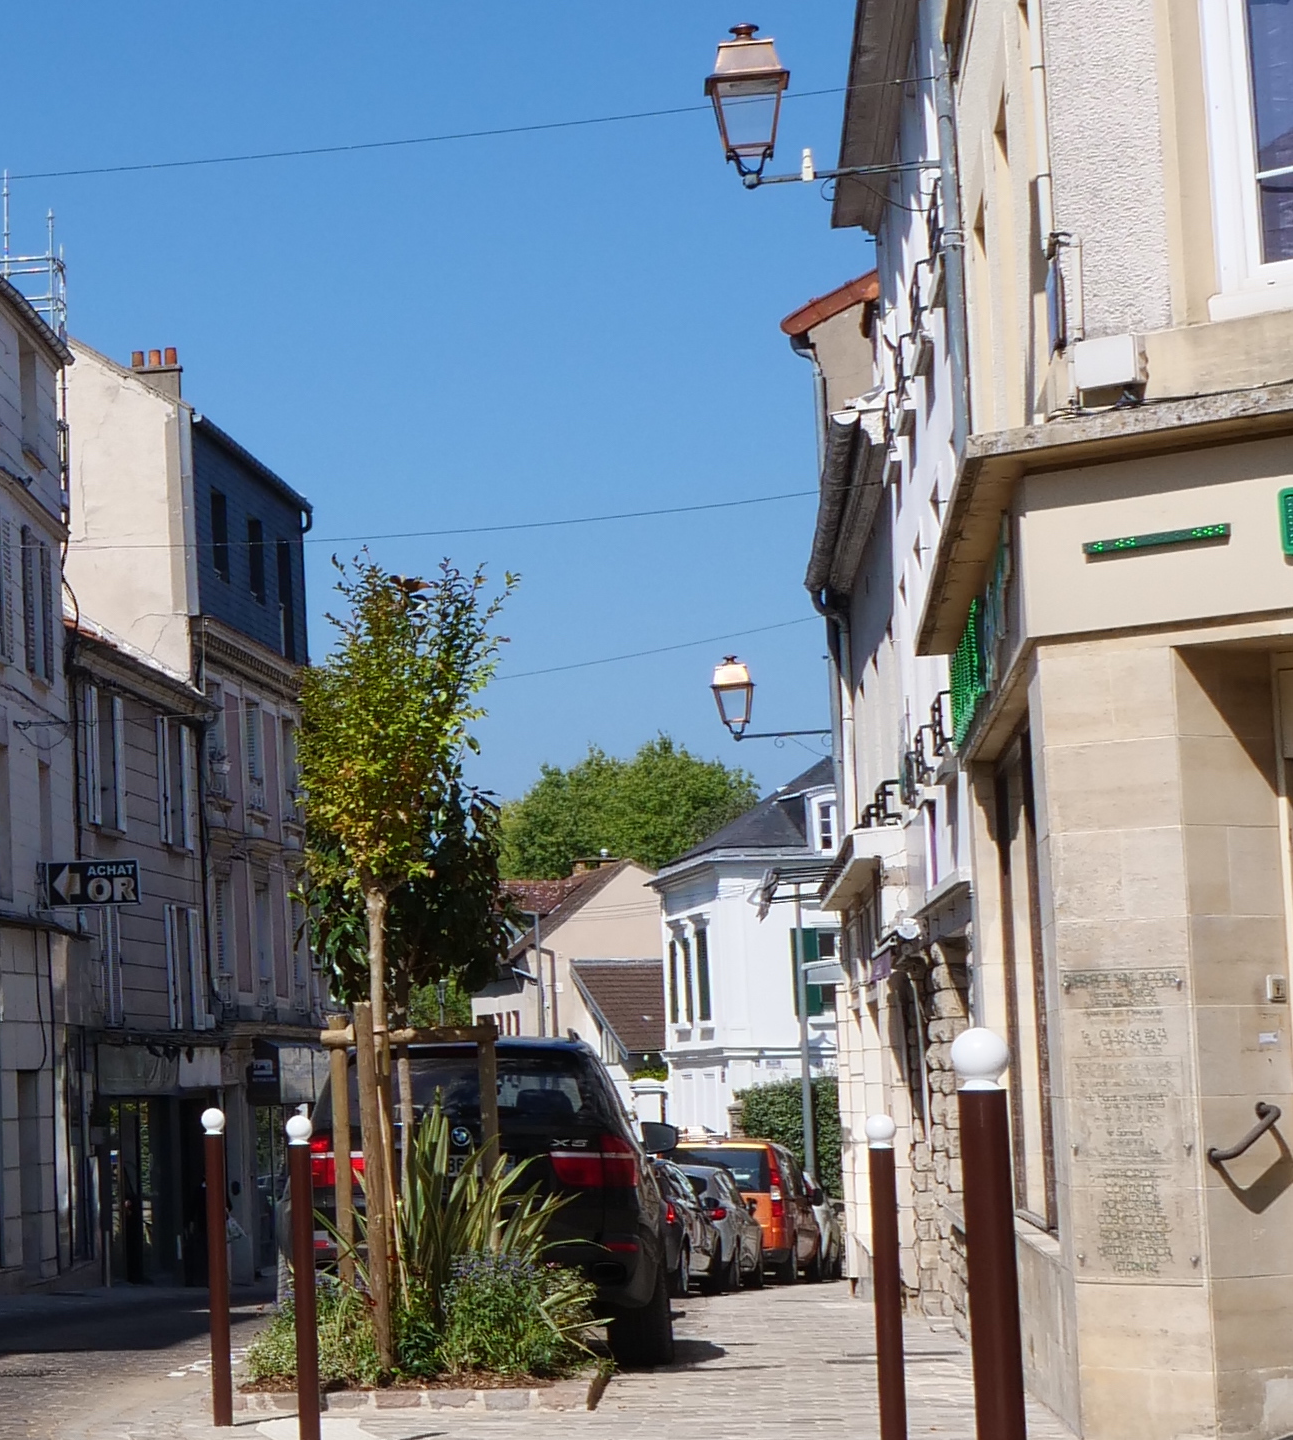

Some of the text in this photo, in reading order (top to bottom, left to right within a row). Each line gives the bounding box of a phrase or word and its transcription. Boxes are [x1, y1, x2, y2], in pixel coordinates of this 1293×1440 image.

[87, 864, 135, 876] ACHAT
[87, 876, 137, 902] OR
[549, 1138, 589, 1148] X5
